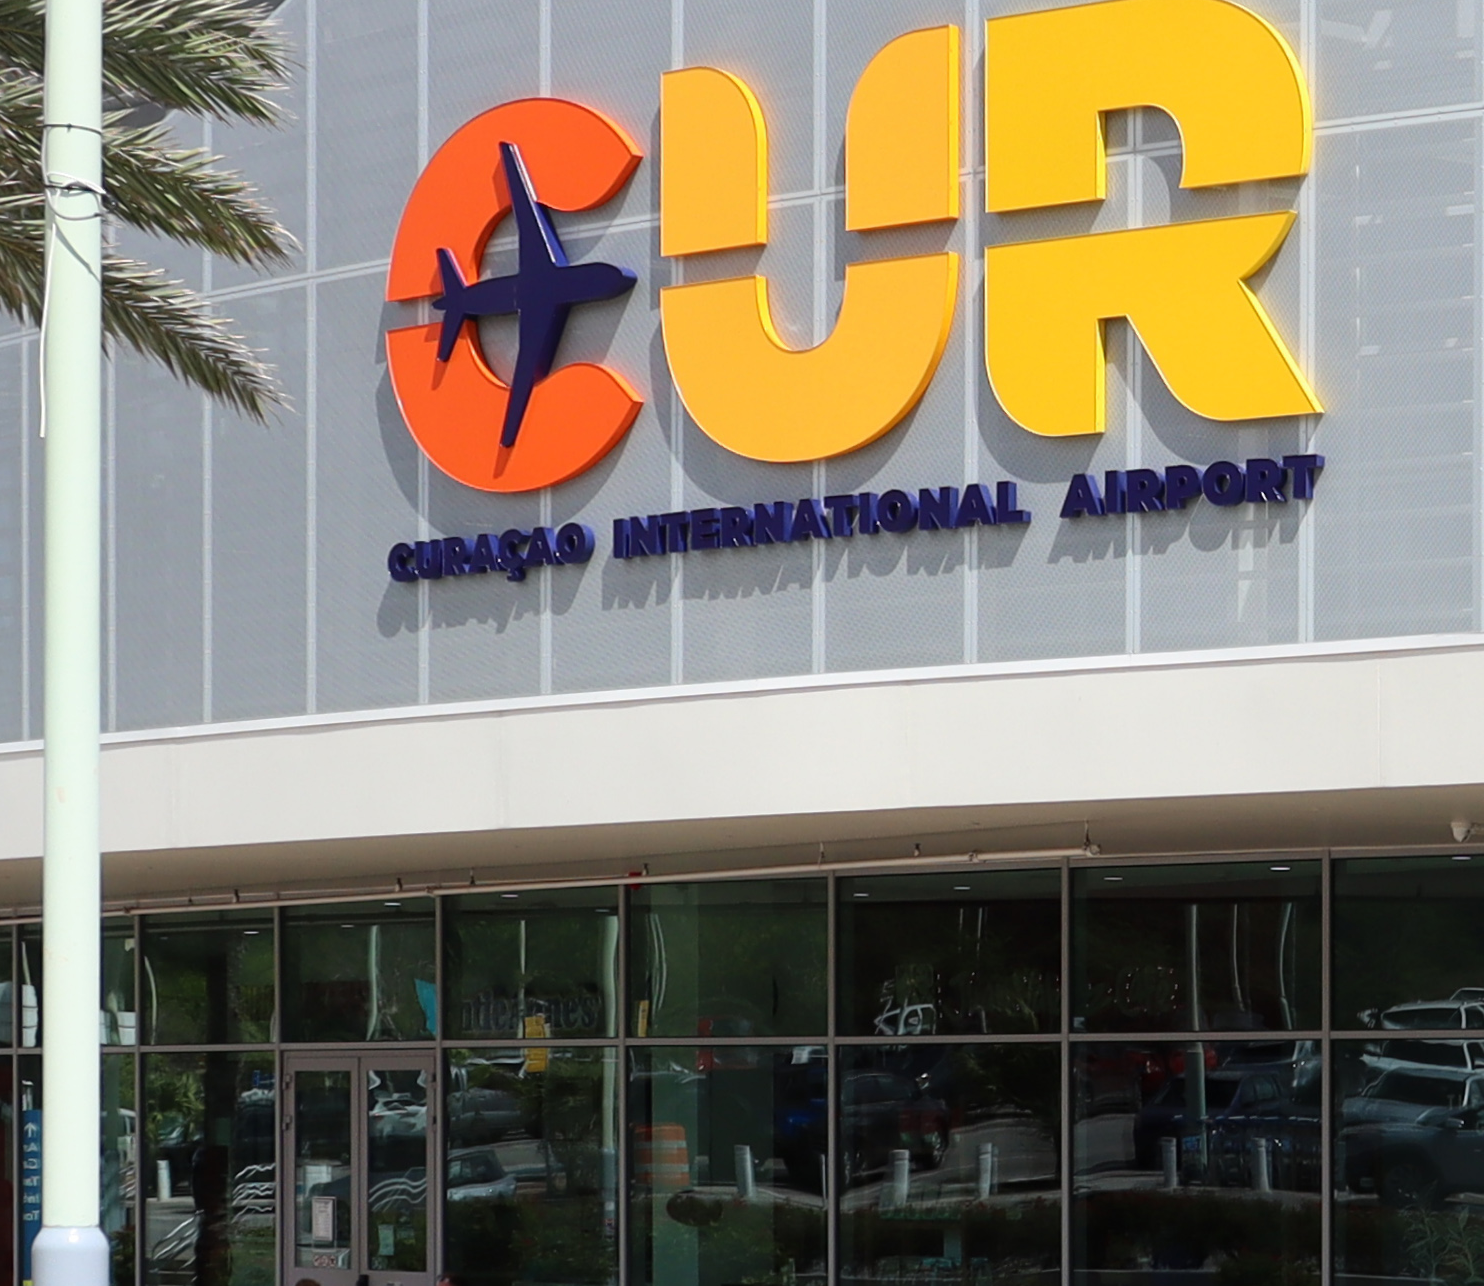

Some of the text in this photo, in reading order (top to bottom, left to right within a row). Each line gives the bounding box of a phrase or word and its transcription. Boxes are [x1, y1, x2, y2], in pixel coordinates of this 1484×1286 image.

[388, 454, 1325, 581] CURAÇAO INTERNATIONAL AIRPORT
